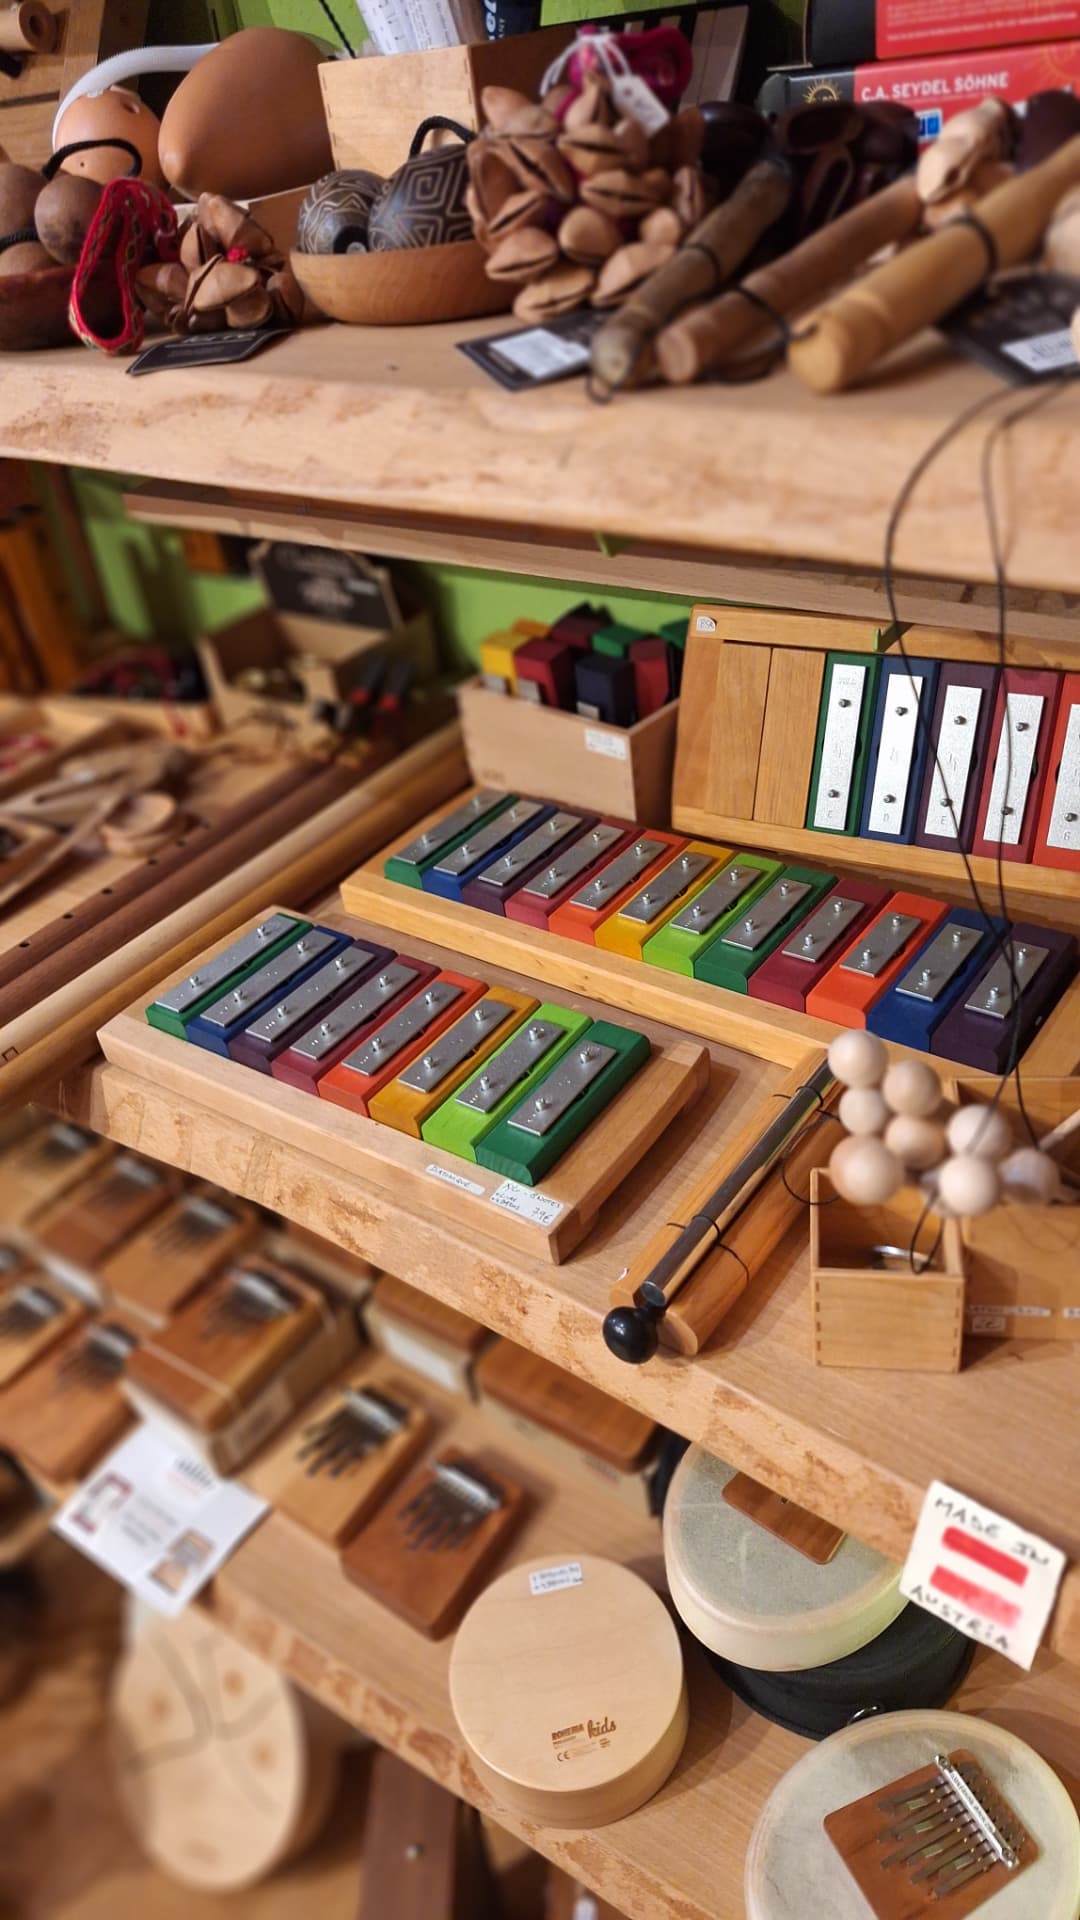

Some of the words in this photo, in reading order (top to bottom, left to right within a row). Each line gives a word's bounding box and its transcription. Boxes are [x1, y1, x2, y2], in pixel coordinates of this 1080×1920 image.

[861, 85, 889, 101] C.A.
[891, 79, 948, 99] SEYDEL
[954, 72, 1009, 92] SÖHNE
[587, 1716, 617, 1739] kids
